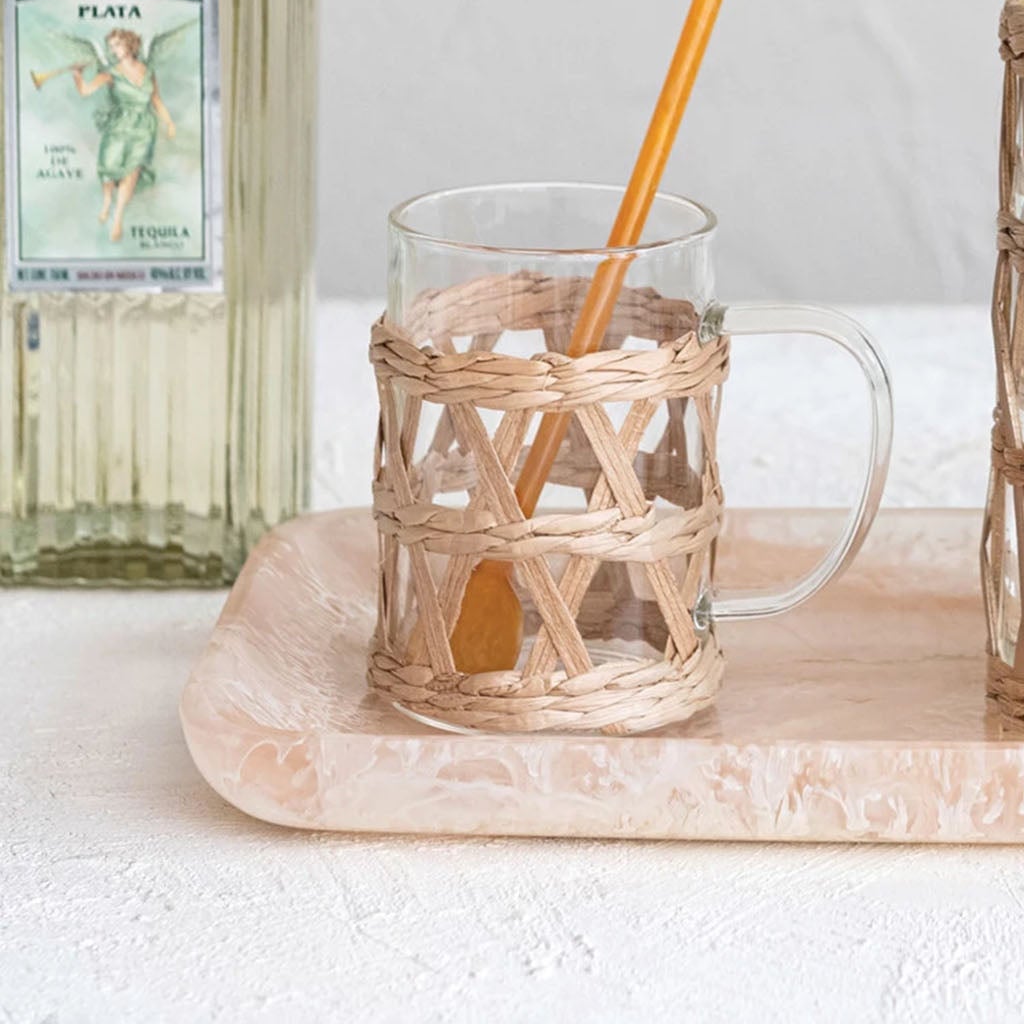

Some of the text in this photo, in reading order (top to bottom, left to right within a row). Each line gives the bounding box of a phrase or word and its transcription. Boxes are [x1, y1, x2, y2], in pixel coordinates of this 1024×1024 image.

[78, 5, 141, 19] PLATA
[36, 168, 83, 178] AGAVE
[131, 225, 191, 239] TEQUILA
